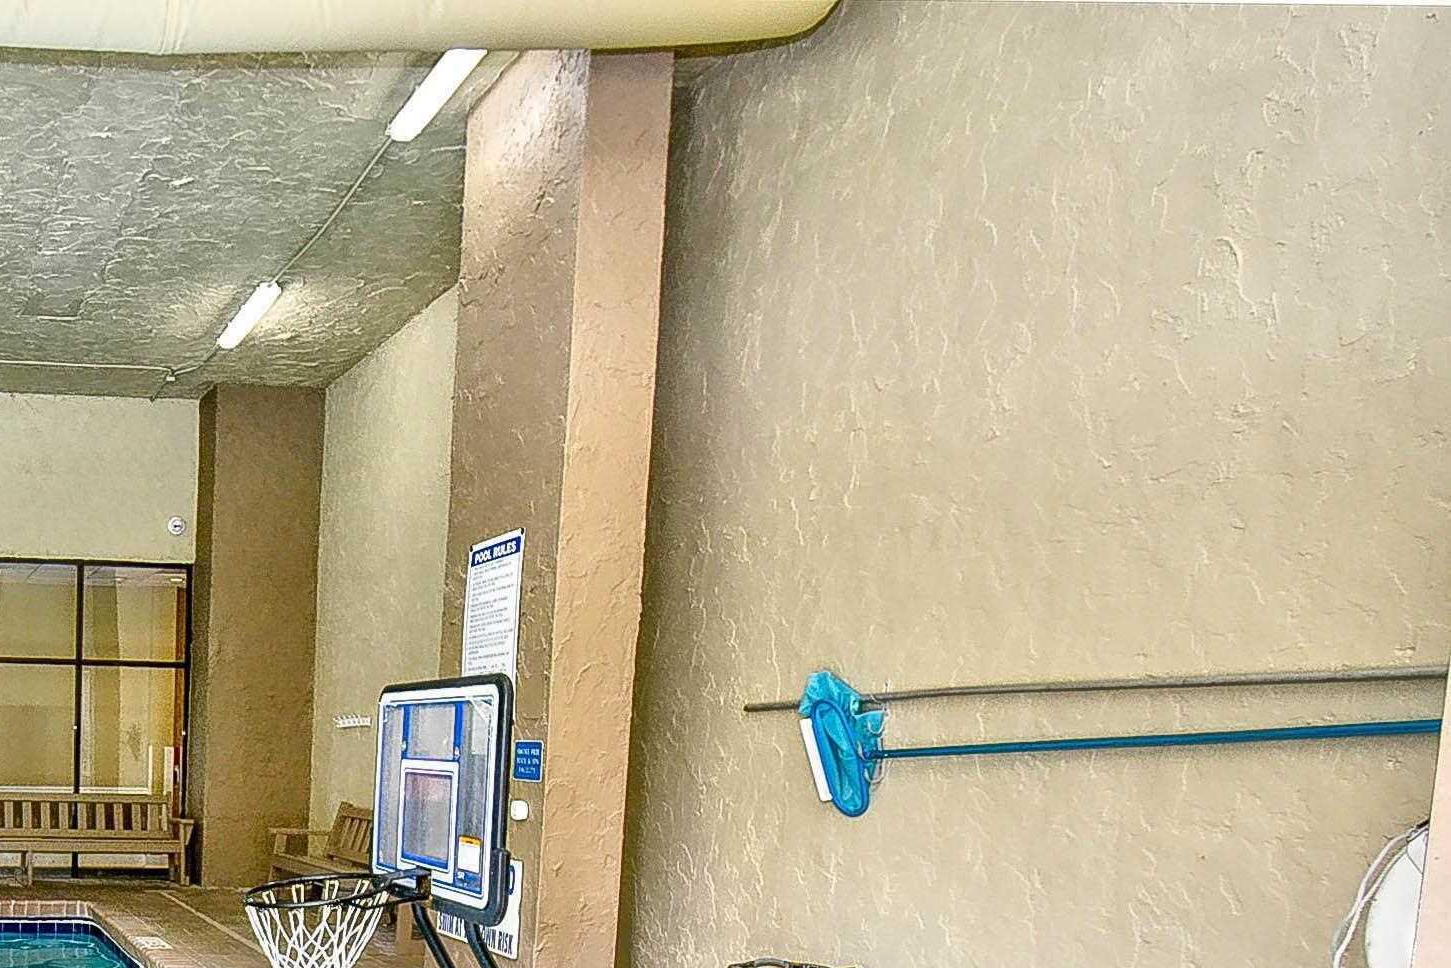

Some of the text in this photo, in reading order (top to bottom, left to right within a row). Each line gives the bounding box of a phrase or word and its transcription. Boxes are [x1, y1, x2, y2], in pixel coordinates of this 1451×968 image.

[474, 540, 517, 565] POOL RULES
[497, 930, 514, 955] RISK
